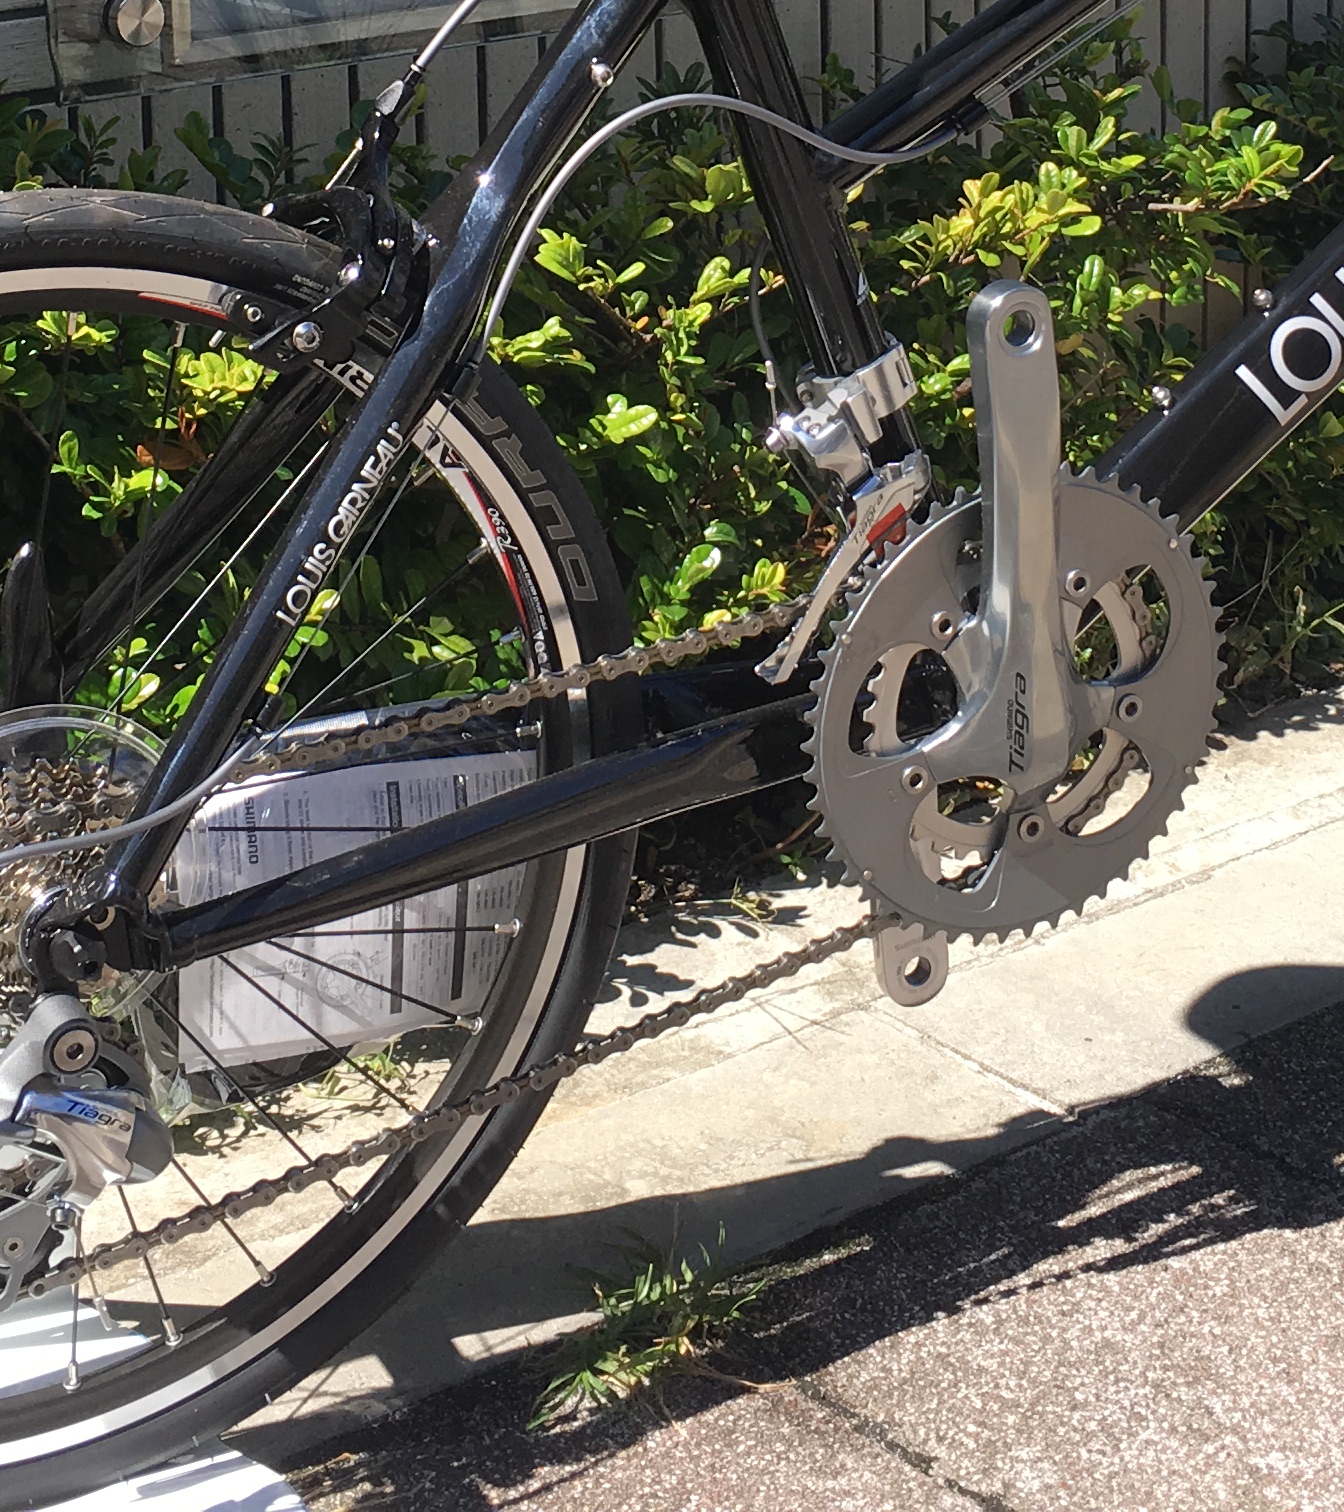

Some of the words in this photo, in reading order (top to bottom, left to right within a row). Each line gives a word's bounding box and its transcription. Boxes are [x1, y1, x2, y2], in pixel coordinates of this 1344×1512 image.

[275, 541, 337, 628] LOUIS
[327, 427, 405, 544] GARNEAU
[487, 506, 519, 555] R390
[1008, 671, 1030, 774] Tiagra
[243, 794, 259, 866] SHIMANO
[66, 1099, 132, 1133] Tiagra
